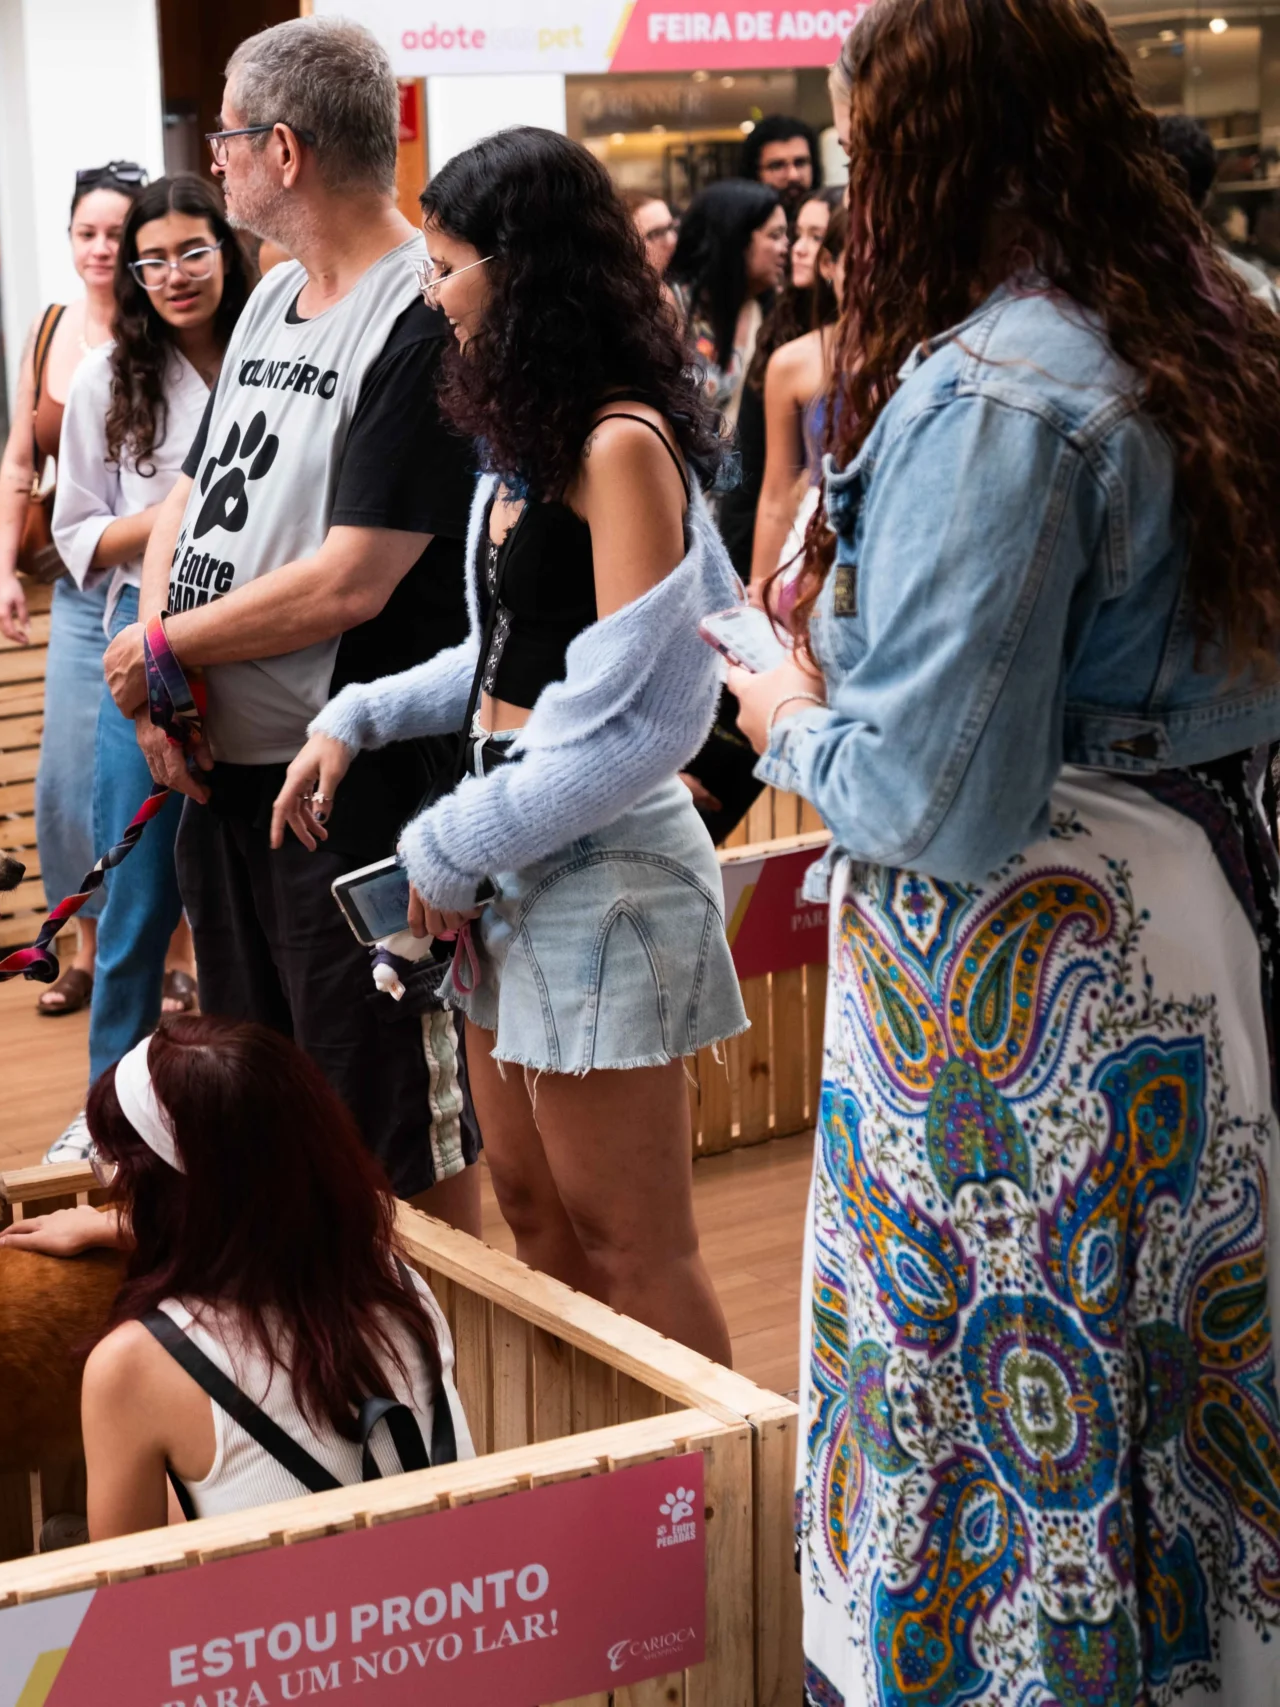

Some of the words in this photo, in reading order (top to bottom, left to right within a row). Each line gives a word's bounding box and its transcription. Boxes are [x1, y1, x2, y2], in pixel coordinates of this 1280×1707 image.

[401, 21, 487, 50] adote
[537, 24, 584, 51] pet
[648, 12, 732, 42] FEIRA
[735, 11, 774, 41] DE
[177, 545, 235, 594] Entre
[792, 909, 829, 932] PAR
[656, 1530, 696, 1548] PEGADAS
[672, 1521, 696, 1535] Entre
[169, 1611, 337, 1687] ESTOU
[350, 1563, 550, 1643] PRONTO
[278, 1661, 342, 1700] UM
[351, 1632, 463, 1684] NOVO
[473, 1609, 560, 1654] LAR!
[630, 1626, 696, 1657] CARIOCA
